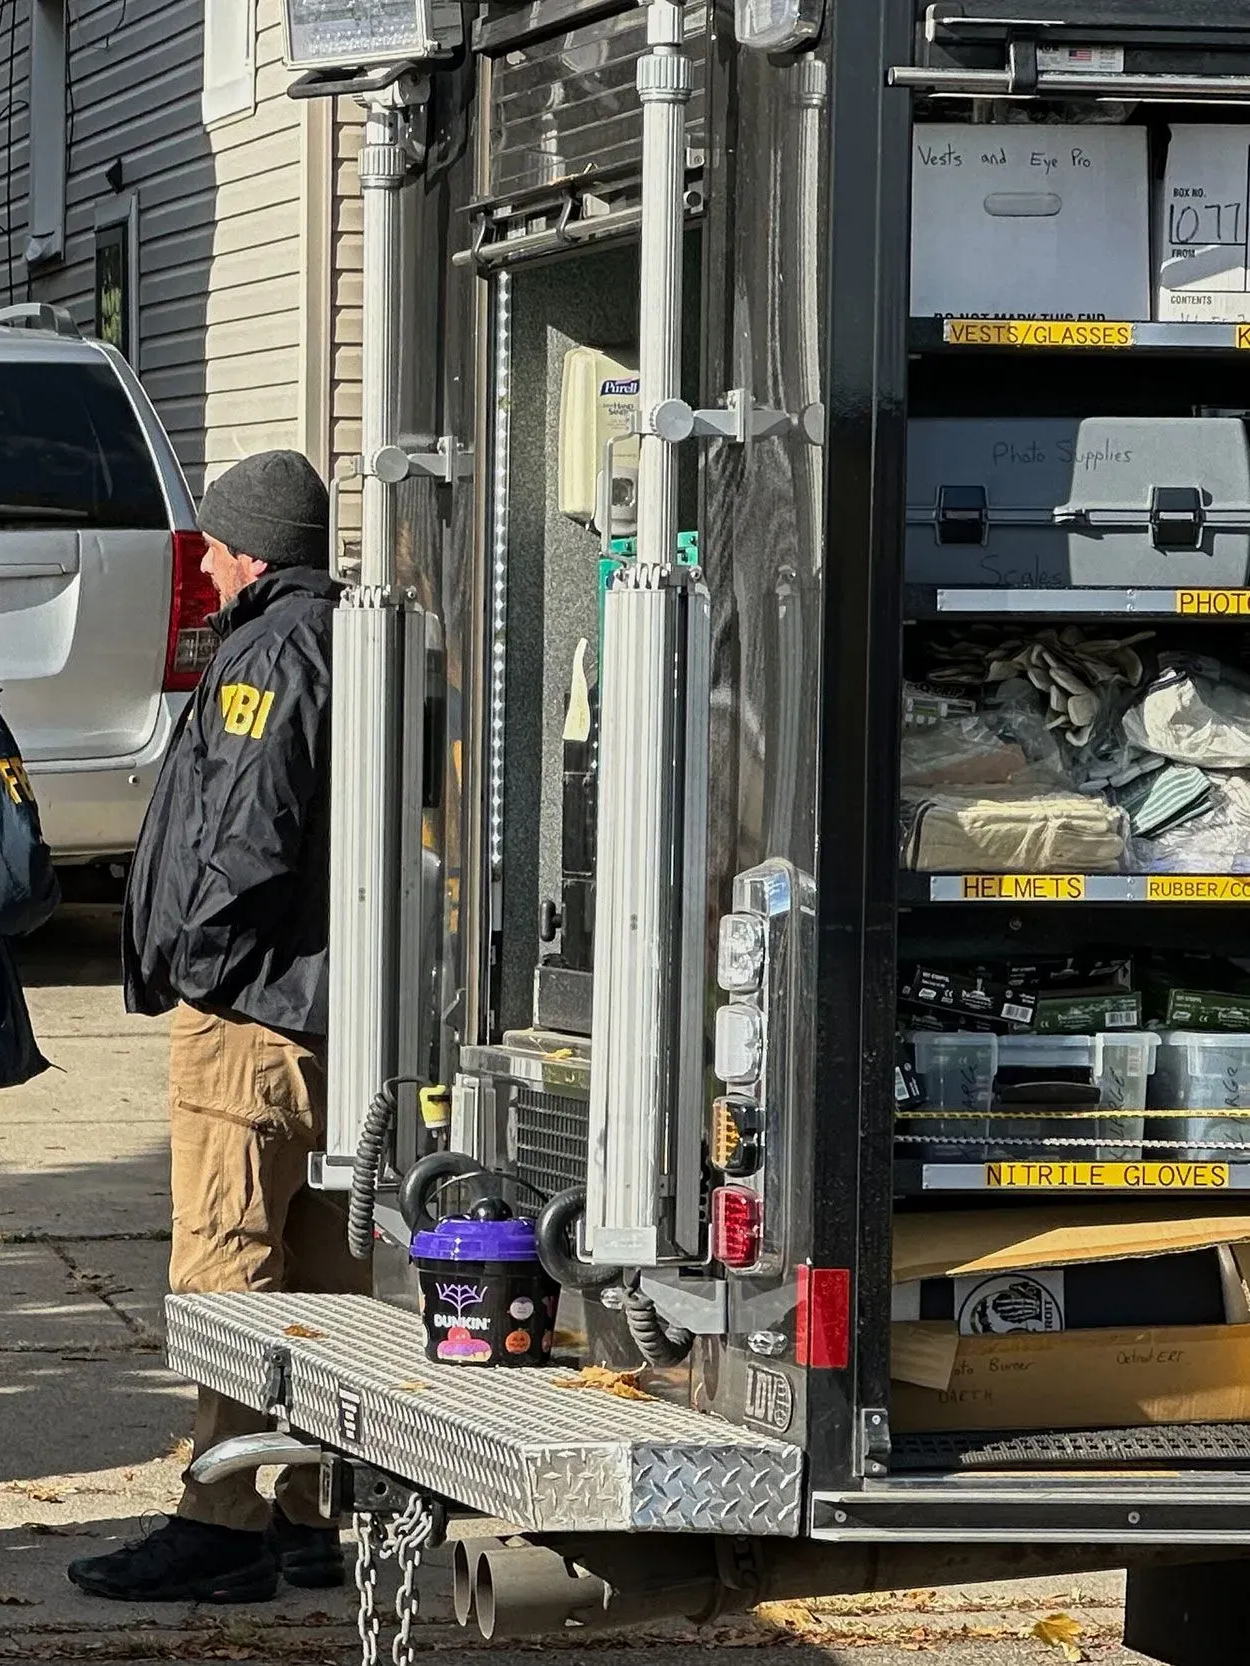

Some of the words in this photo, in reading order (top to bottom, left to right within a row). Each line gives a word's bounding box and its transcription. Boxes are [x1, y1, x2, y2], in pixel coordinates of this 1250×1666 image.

[918, 144, 962, 167] Vests
[981, 148, 1006, 165] and
[1030, 152, 1057, 175] Eye
[1071, 148, 1091, 168] Pro
[1173, 188, 1190, 197] BOX
[1169, 203, 1241, 243] 1077
[1172, 249, 1196, 258] FROM
[1171, 296, 1212, 305] CONTENTS
[951, 324, 1129, 346] VESTS/GLASSES
[604, 381, 638, 393] Purell
[993, 441, 1046, 467] Photo
[1056, 439, 1133, 470] Supplies
[980, 554, 1064, 586] Scales
[1180, 592, 1250, 614] PHOT
[964, 876, 1081, 899] HELMETS
[987, 1165, 1105, 1187] NITRILE
[1124, 1164, 1226, 1187] GLOVES
[434, 1313, 491, 1331] DUNKIN'
[1044, 1299, 1054, 1332] ROIT
